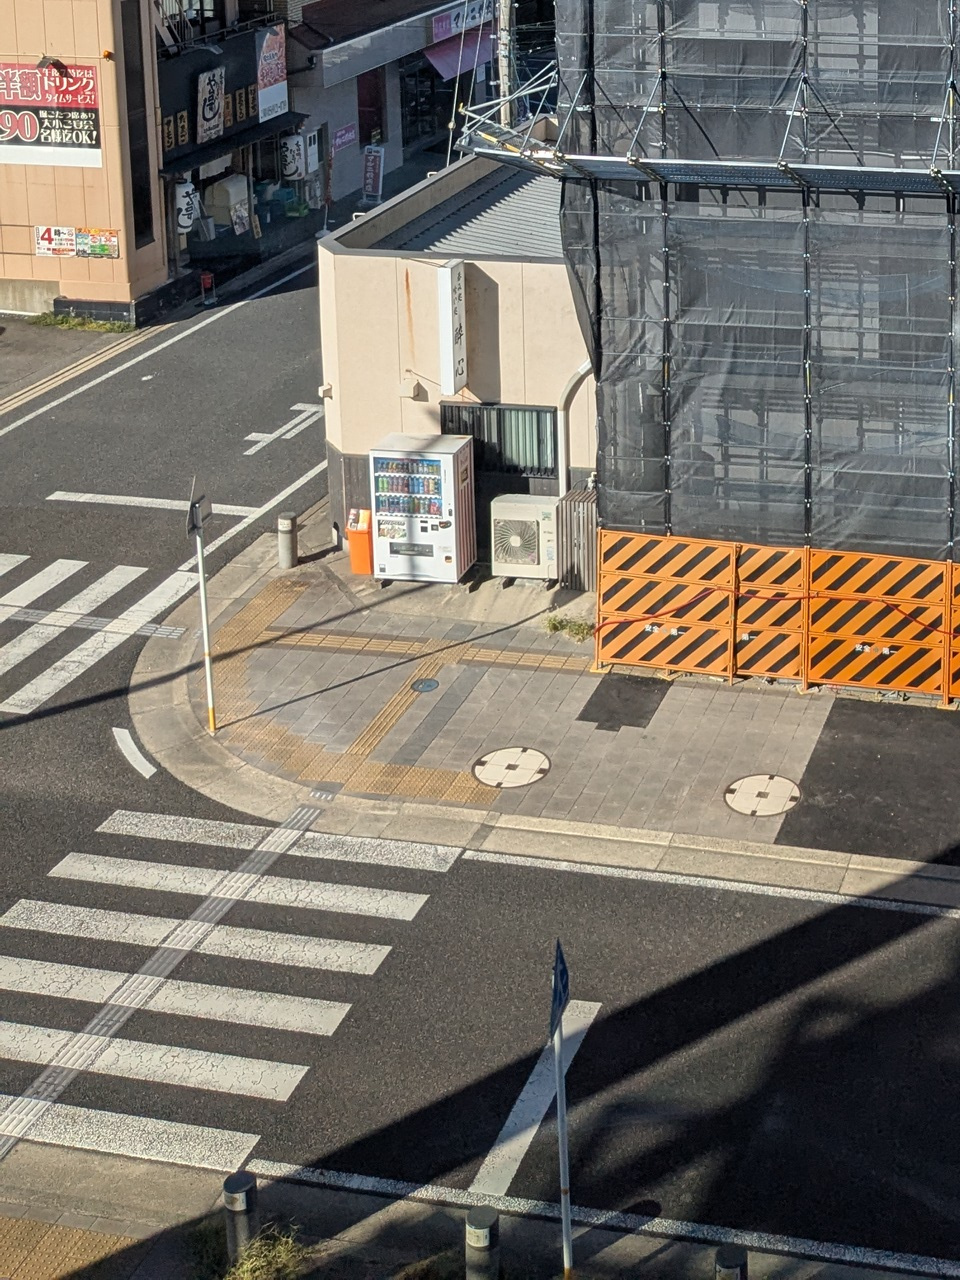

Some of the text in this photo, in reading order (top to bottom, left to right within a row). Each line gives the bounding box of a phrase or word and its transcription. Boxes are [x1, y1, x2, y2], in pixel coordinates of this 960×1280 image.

[43, 77, 95, 93] ドリンク
[45, 93, 95, 105] タイムサービス!
[0, 110, 40, 142] 90
[40, 129, 98, 145] 名様迄OK!
[644, 624, 686, 636] 安全 第一
[741, 633, 757, 641] 第一
[855, 644, 898, 656] 安全 第一
